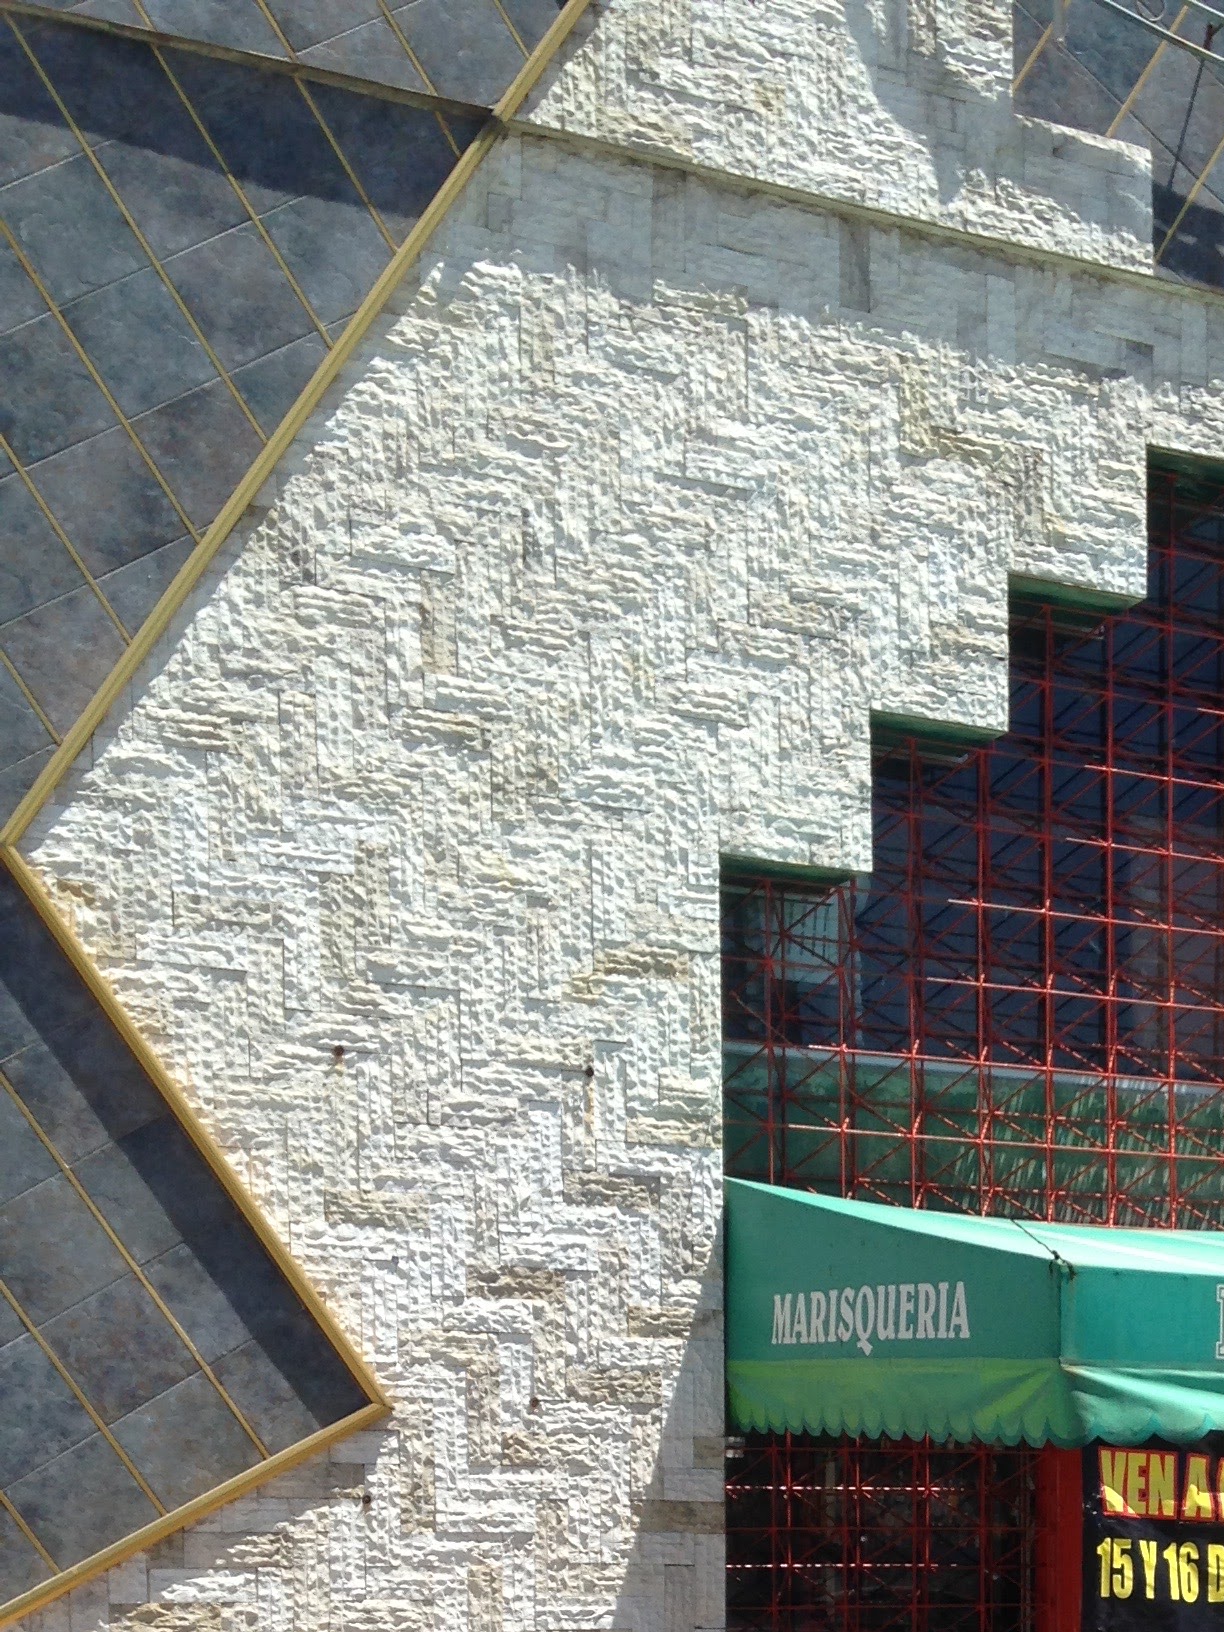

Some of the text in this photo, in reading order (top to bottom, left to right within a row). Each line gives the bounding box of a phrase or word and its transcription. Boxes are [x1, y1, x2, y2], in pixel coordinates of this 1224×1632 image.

[770, 1280, 971, 1357] MARISQUERIA
[1098, 1446, 1179, 1520] VEN
[1181, 1453, 1215, 1522] A
[1097, 1537, 1134, 1600] 15
[1140, 1540, 1158, 1600] Y
[1163, 1542, 1199, 1603] 16
